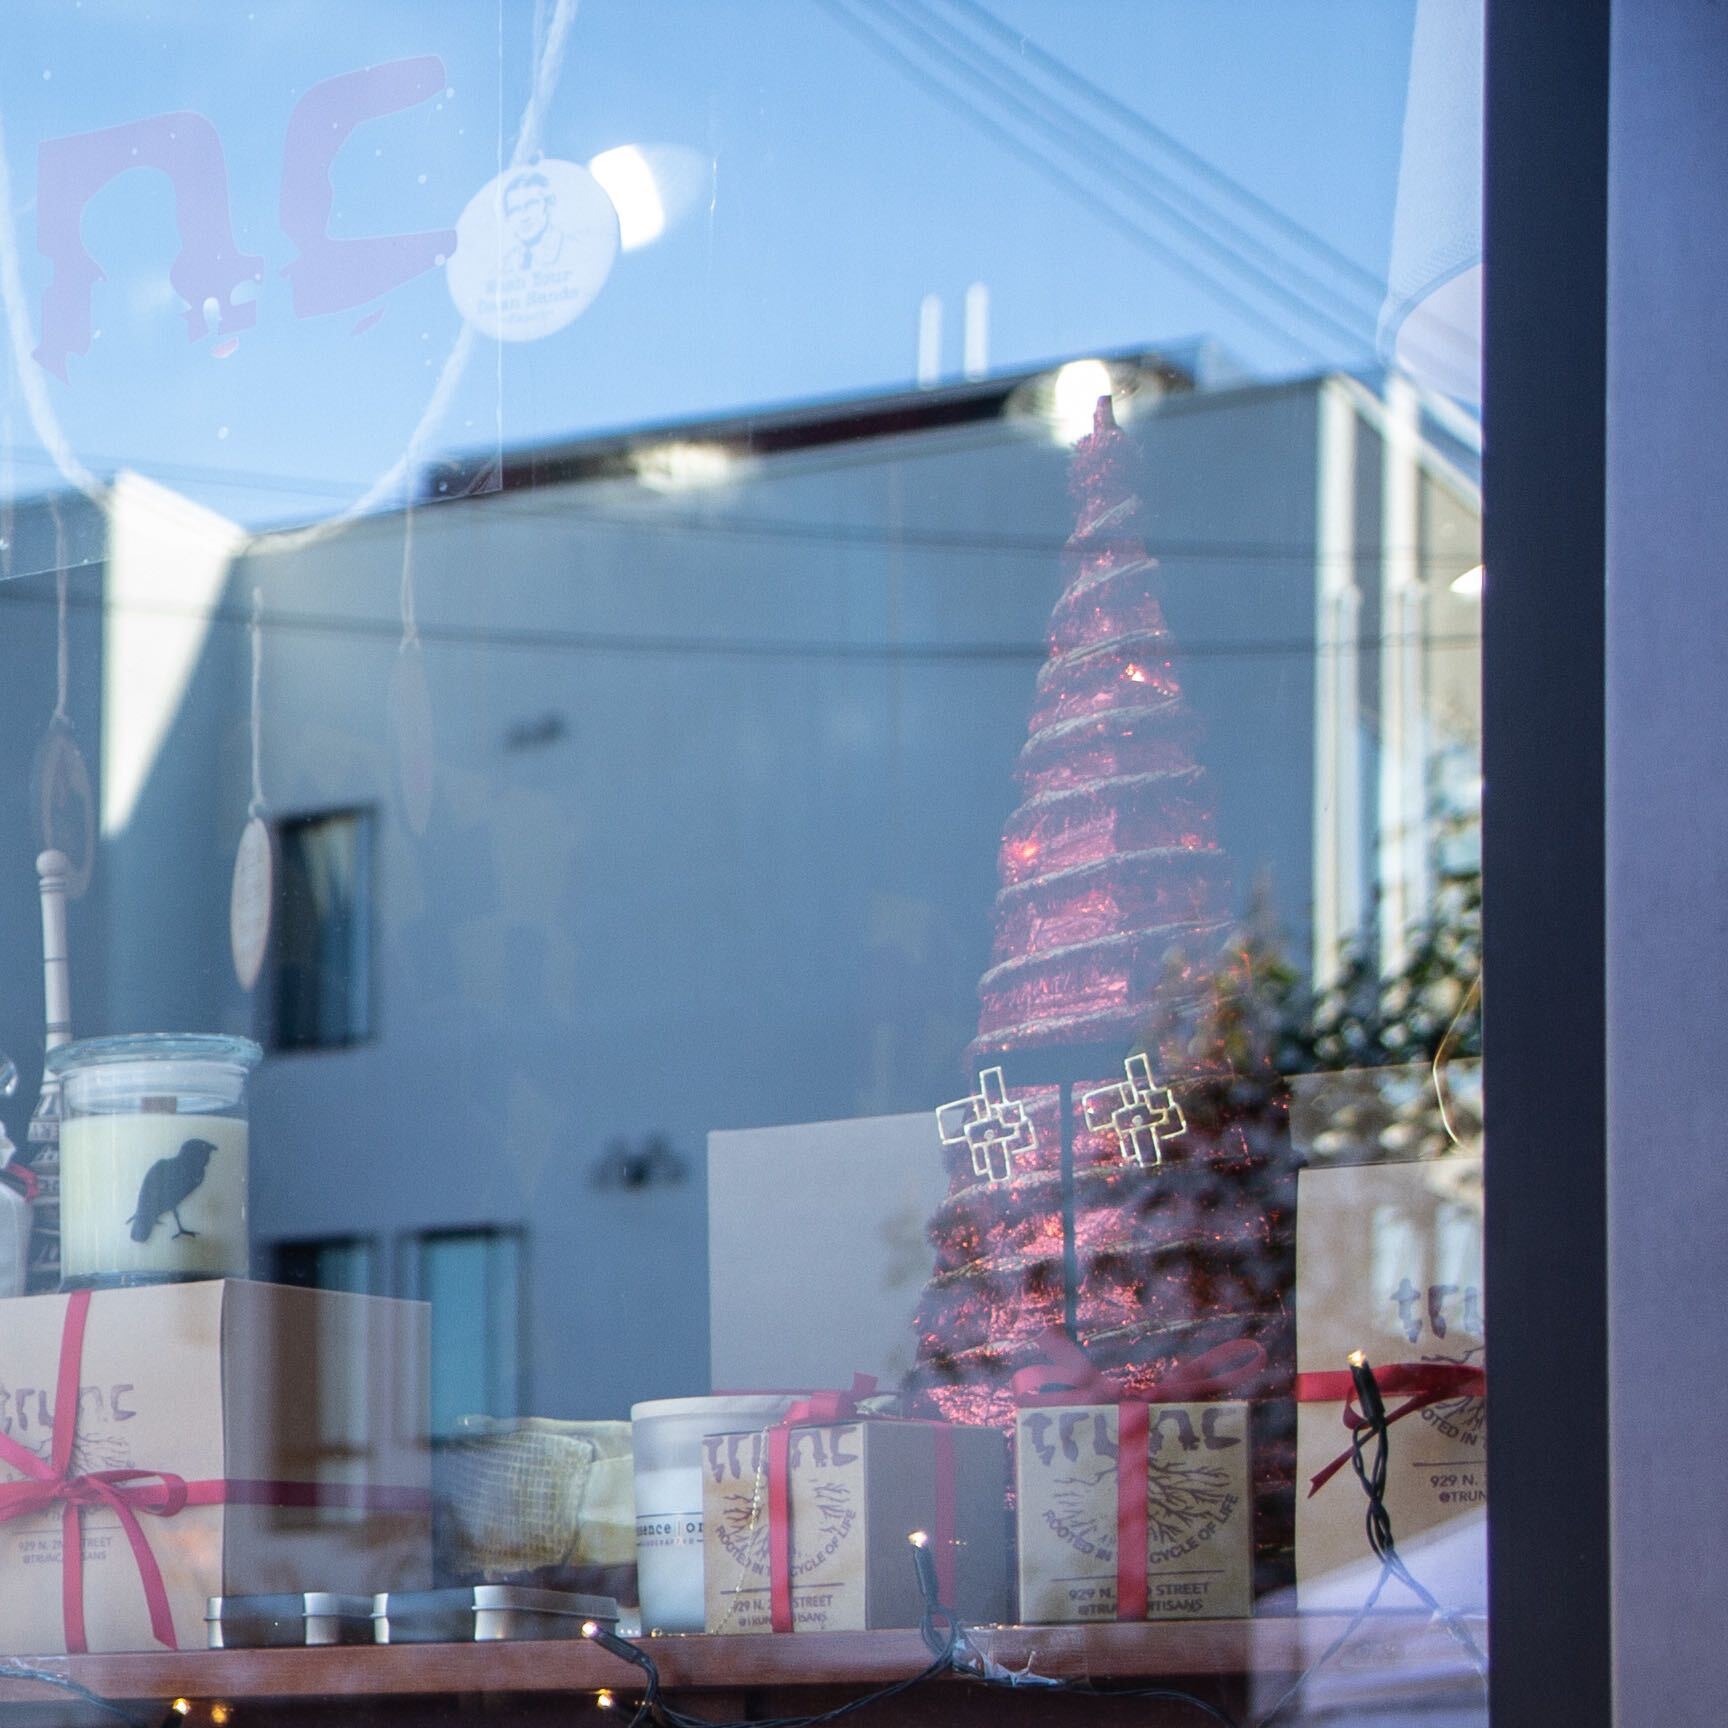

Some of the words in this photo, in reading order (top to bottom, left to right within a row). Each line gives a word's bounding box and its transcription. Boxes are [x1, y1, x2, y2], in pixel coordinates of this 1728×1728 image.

[703, 1425, 859, 1484] trunc
[1430, 1474, 1457, 1488] 929
[1069, 1587, 1095, 1601] 929
[1155, 1581, 1209, 1596] STREET
